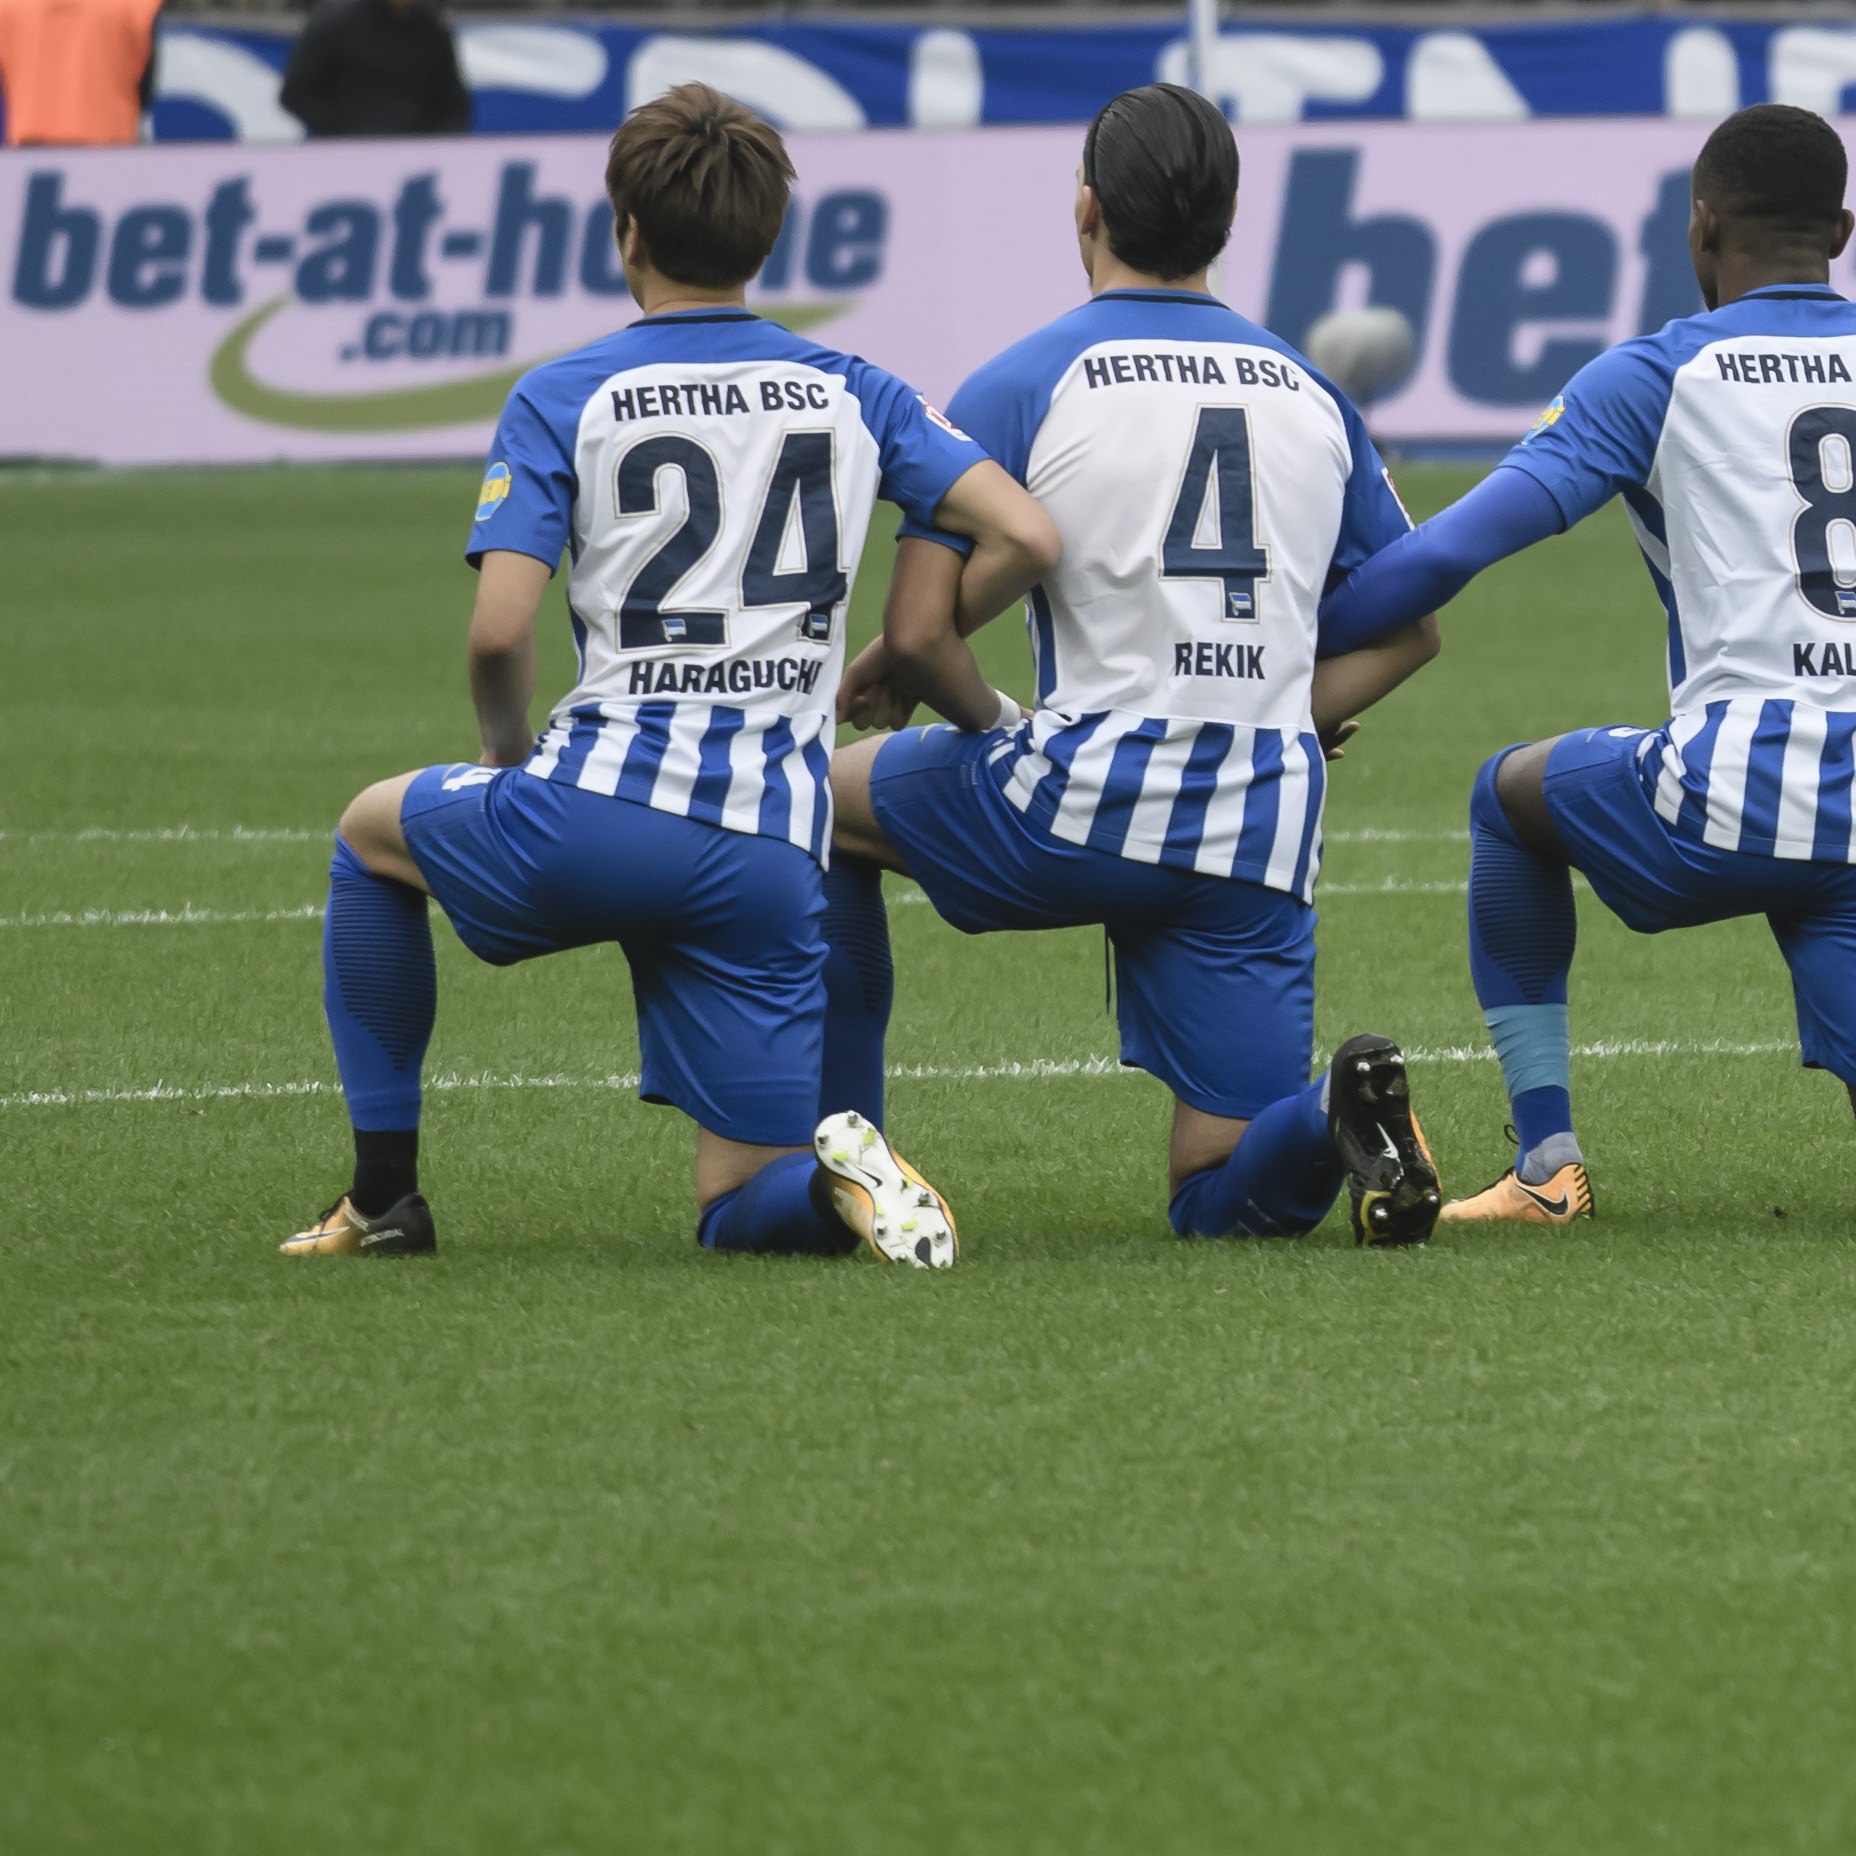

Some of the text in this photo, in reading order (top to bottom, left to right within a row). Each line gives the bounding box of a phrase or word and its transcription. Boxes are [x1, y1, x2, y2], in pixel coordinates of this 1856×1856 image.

[340, 307, 514, 361] .com
[1084, 354, 1301, 392] HERTHA BSC
[1715, 352, 1852, 384] HERTHA
[611, 380, 830, 422] HERTHA BSC
[1157, 402, 1272, 624] 4
[613, 426, 852, 656] 24
[1174, 641, 1266, 680] REKIK
